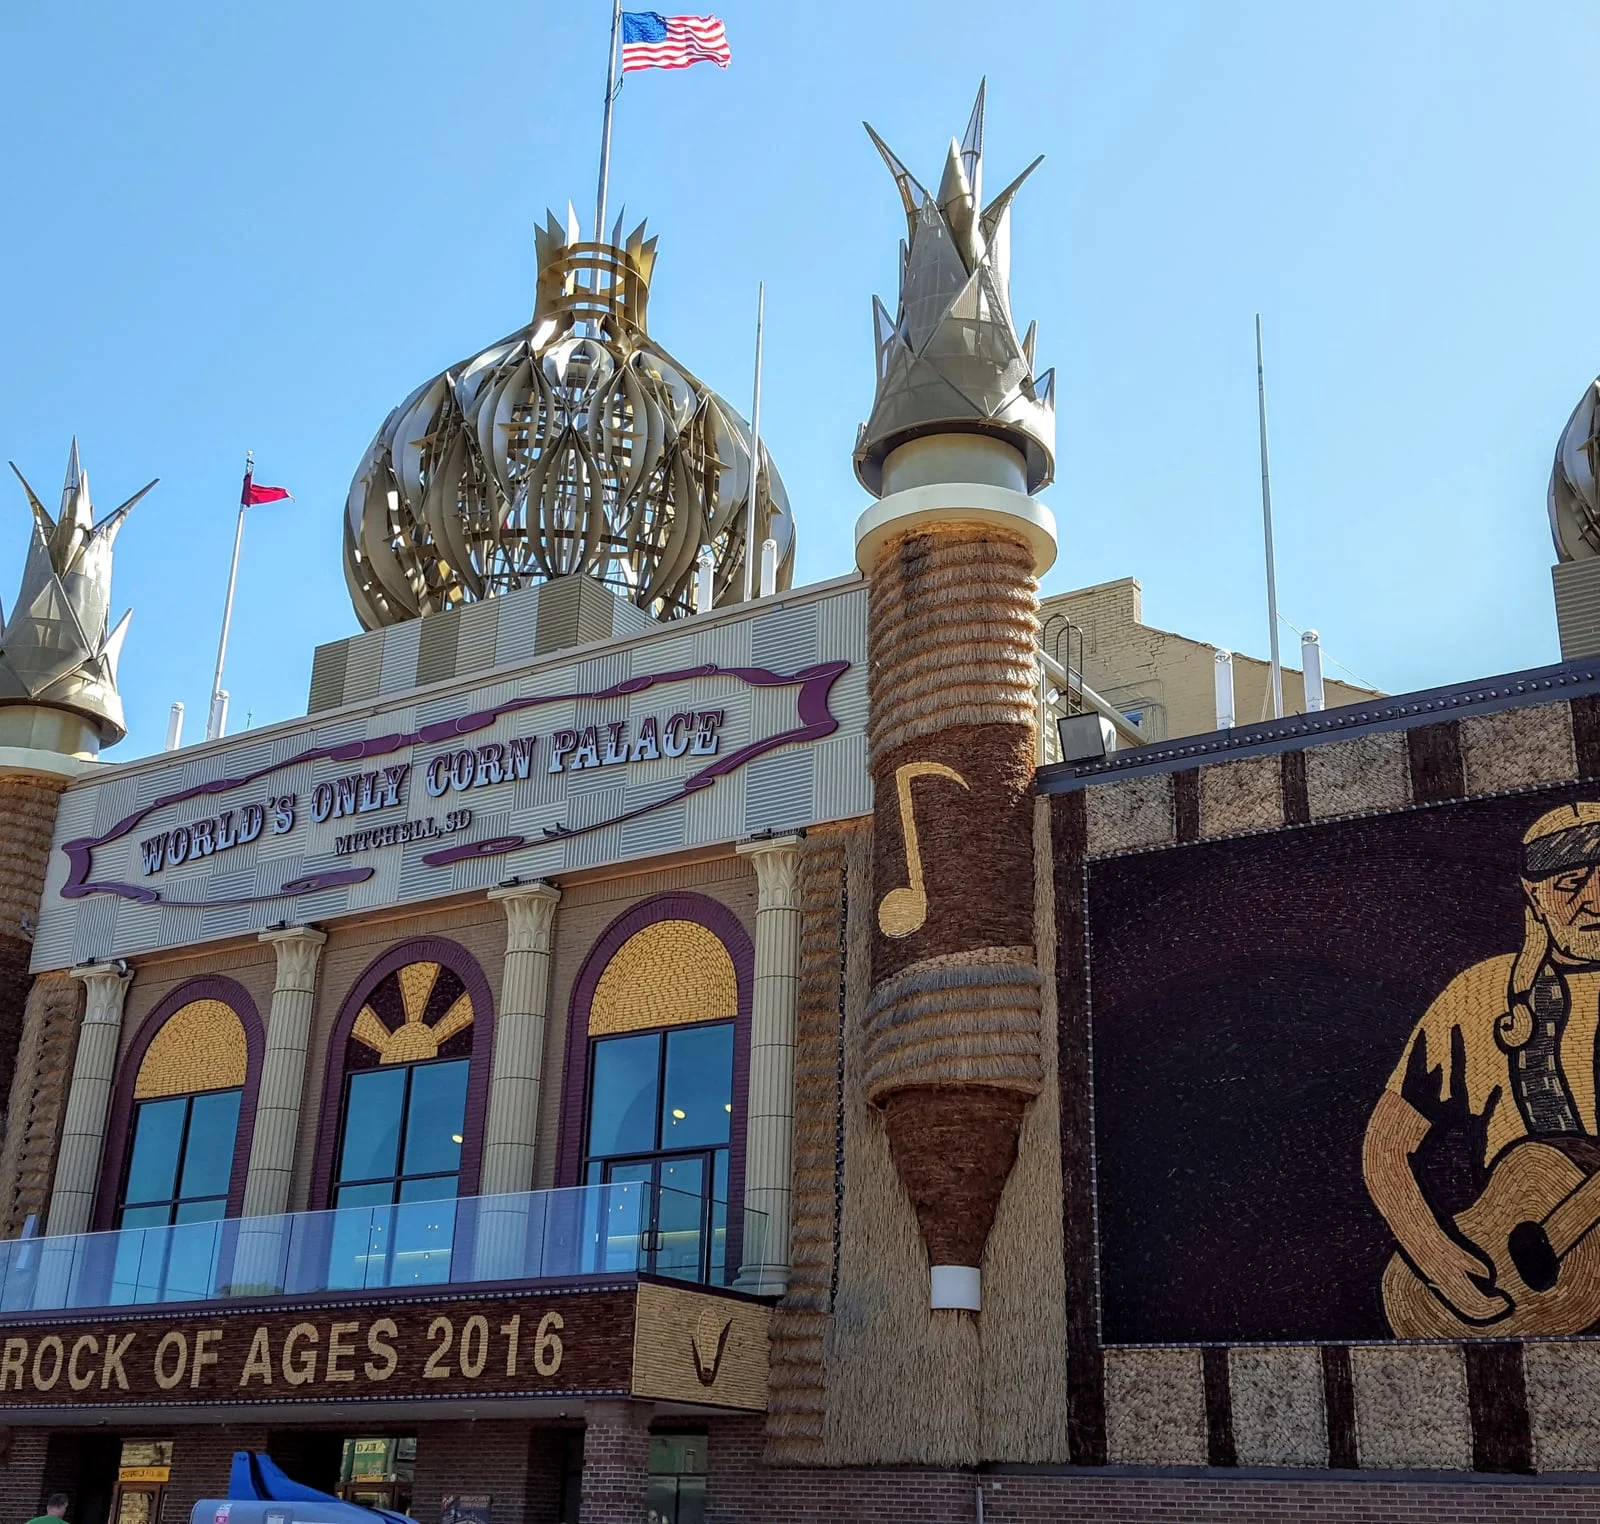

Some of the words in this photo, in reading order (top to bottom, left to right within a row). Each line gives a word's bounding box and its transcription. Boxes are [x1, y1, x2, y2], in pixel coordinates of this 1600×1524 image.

[140, 793, 296, 876] WORLD'S
[310, 763, 410, 823] ONLY
[426, 735, 536, 798] CORN
[548, 709, 724, 774] PALACE
[445, 809, 472, 831] SD
[0, 1333, 136, 1391] ROCK
[154, 1329, 223, 1389] OF
[239, 1318, 398, 1386] AGES
[422, 1311, 565, 1378] 2016
